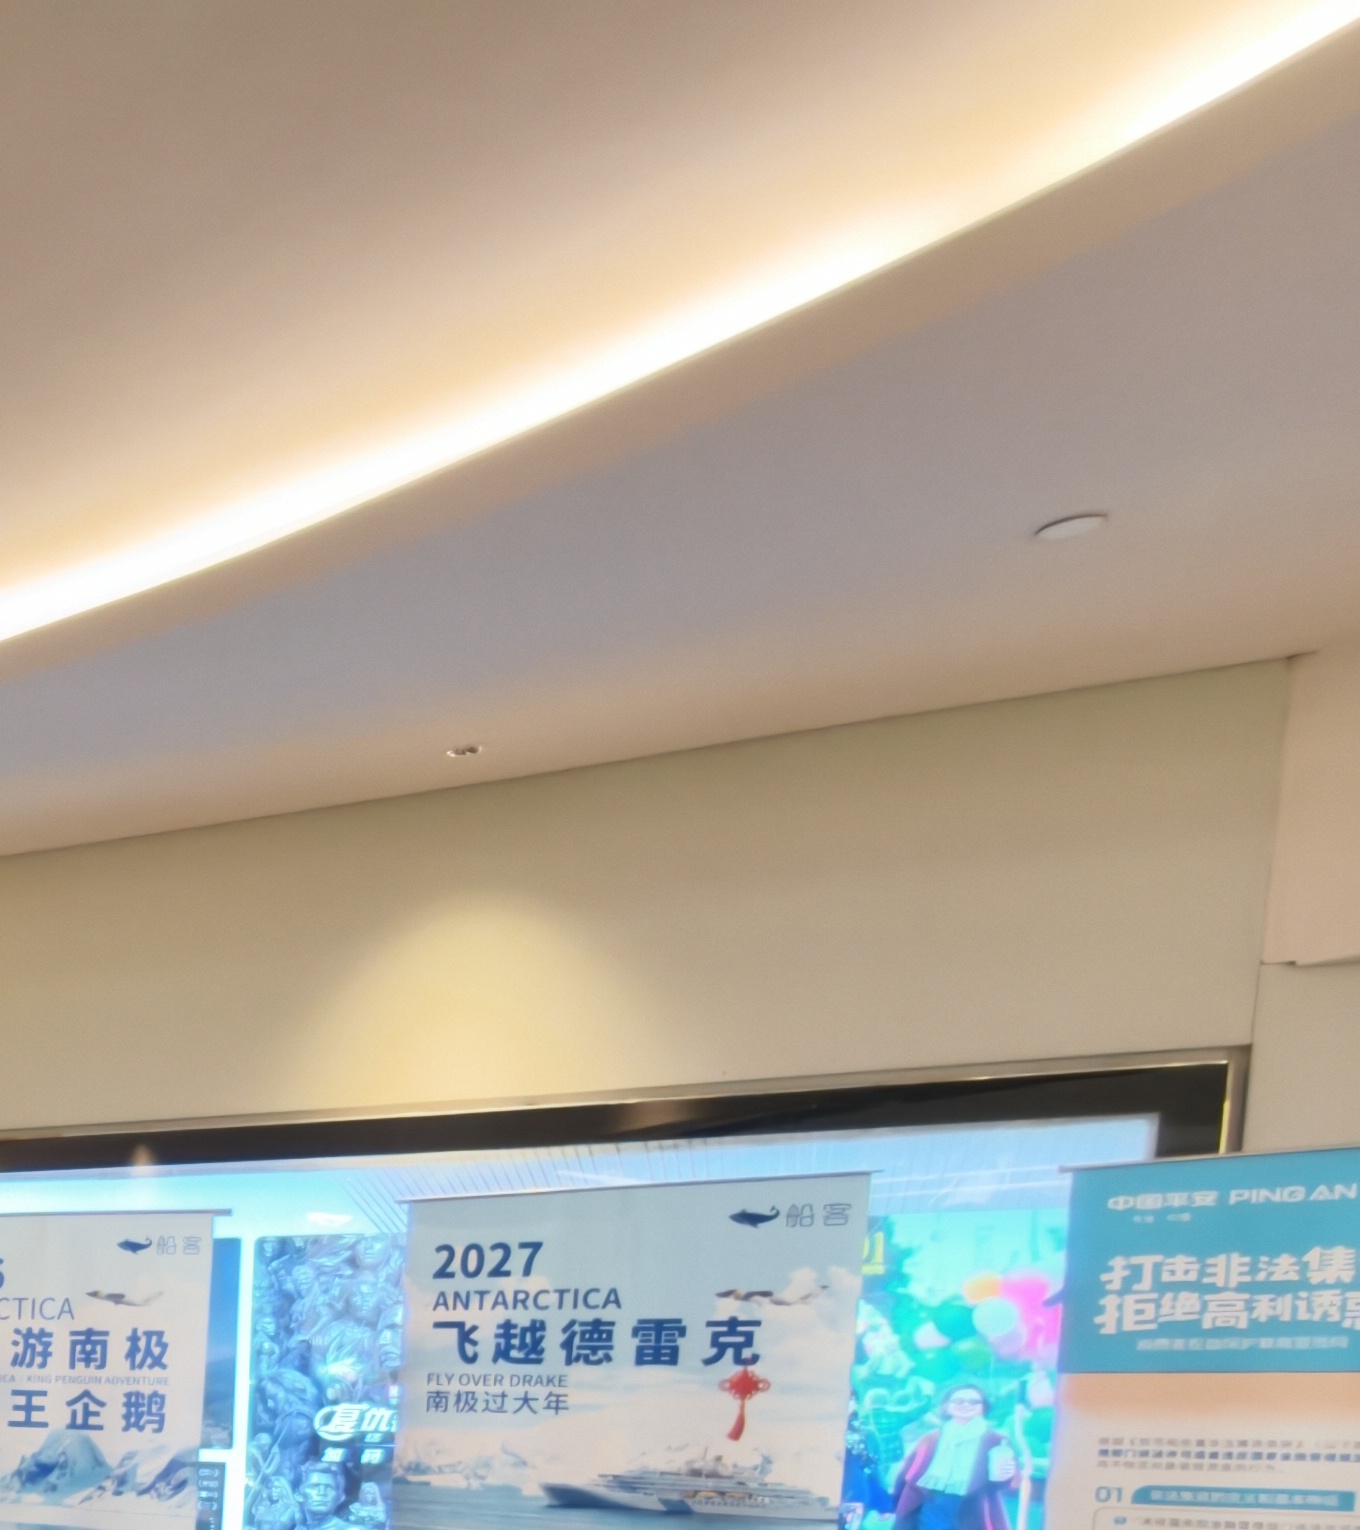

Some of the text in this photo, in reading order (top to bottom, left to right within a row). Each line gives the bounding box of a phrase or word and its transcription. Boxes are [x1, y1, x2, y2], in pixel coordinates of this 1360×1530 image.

[1228, 1186, 1306, 1205] PING
[1309, 1182, 1359, 1201] AN
[786, 1203, 852, 1228] 船客
[156, 1235, 202, 1255] 船客
[433, 1241, 544, 1280] 2027
[433, 1287, 623, 1312] ANTARCTICA
[432, 1316, 763, 1368] 飞越德雷克
[105, 1376, 170, 1387] ADVENTURE
[426, 1373, 569, 1388] FLY OVER DRAKE
[425, 1390, 570, 1416] 南极过大年
[314, 1403, 397, 1435] 复仇
